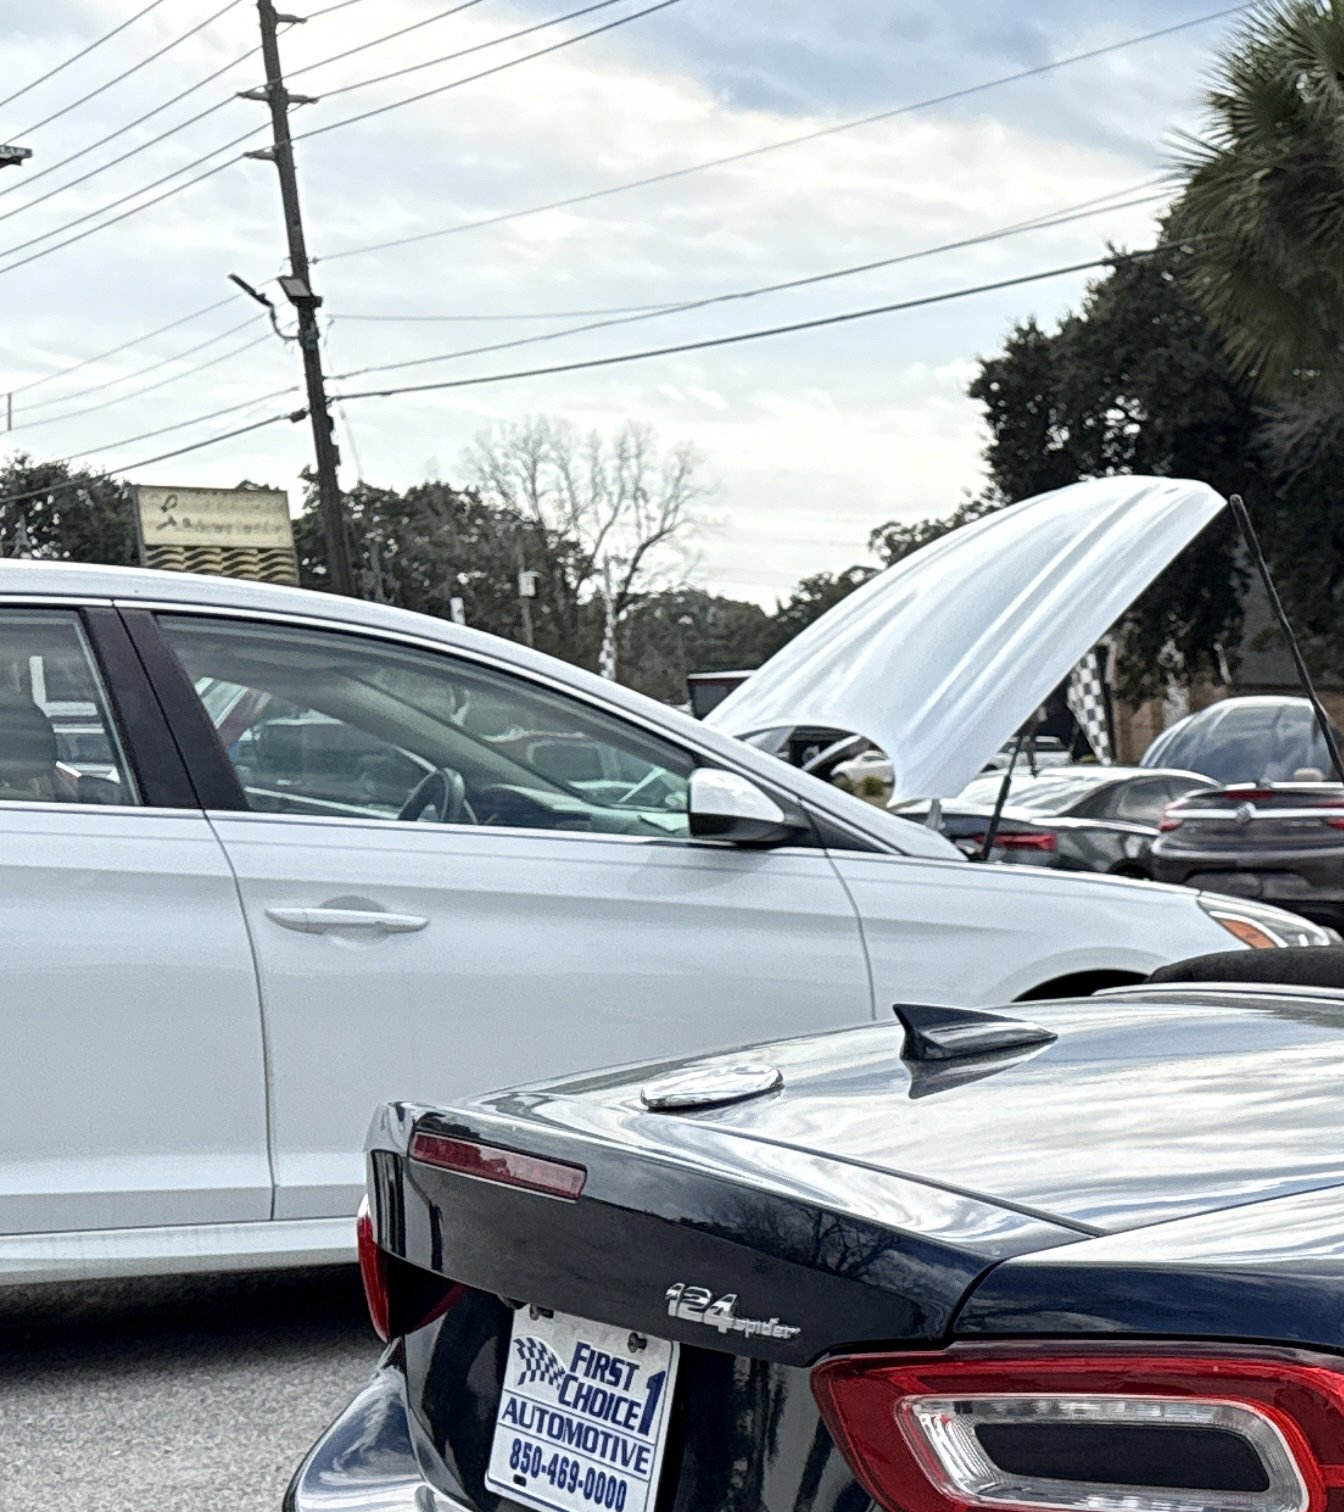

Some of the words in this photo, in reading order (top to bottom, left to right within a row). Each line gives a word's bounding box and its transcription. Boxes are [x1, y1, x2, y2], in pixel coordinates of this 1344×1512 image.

[665, 1283, 737, 1333] 124
[569, 1341, 640, 1391] FIRST
[502, 1397, 651, 1474] AUTOMOTIVE
[558, 1374, 642, 1431] CHOICE
[637, 1371, 666, 1436] 1
[510, 1438, 627, 1512] 850-469-0000
